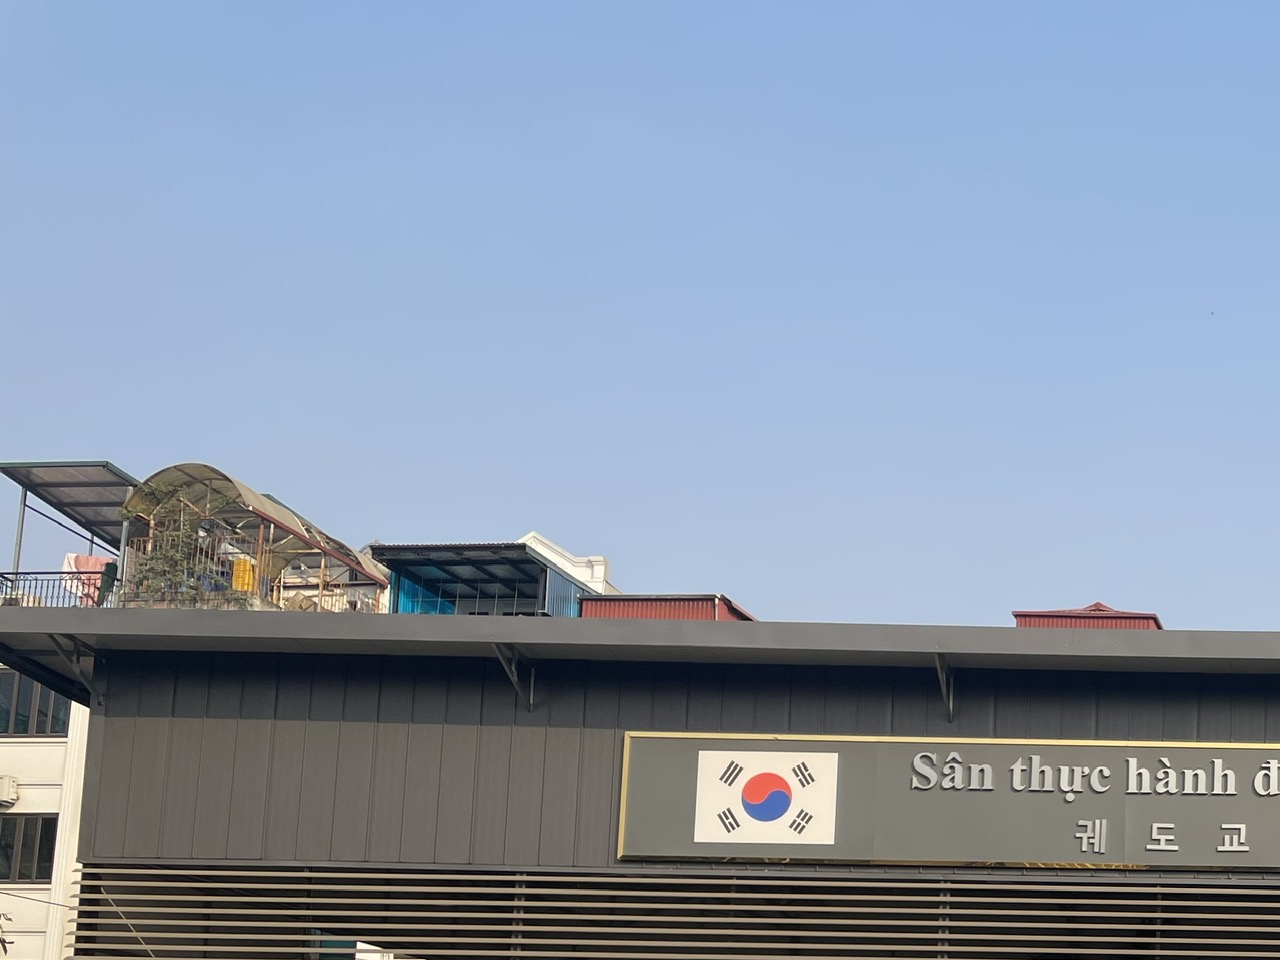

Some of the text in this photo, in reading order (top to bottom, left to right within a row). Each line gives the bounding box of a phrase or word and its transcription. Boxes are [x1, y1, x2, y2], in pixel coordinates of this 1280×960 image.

[911, 752, 995, 790] Sân
[1009, 755, 1111, 802] thực
[1125, 757, 1238, 795] hành
